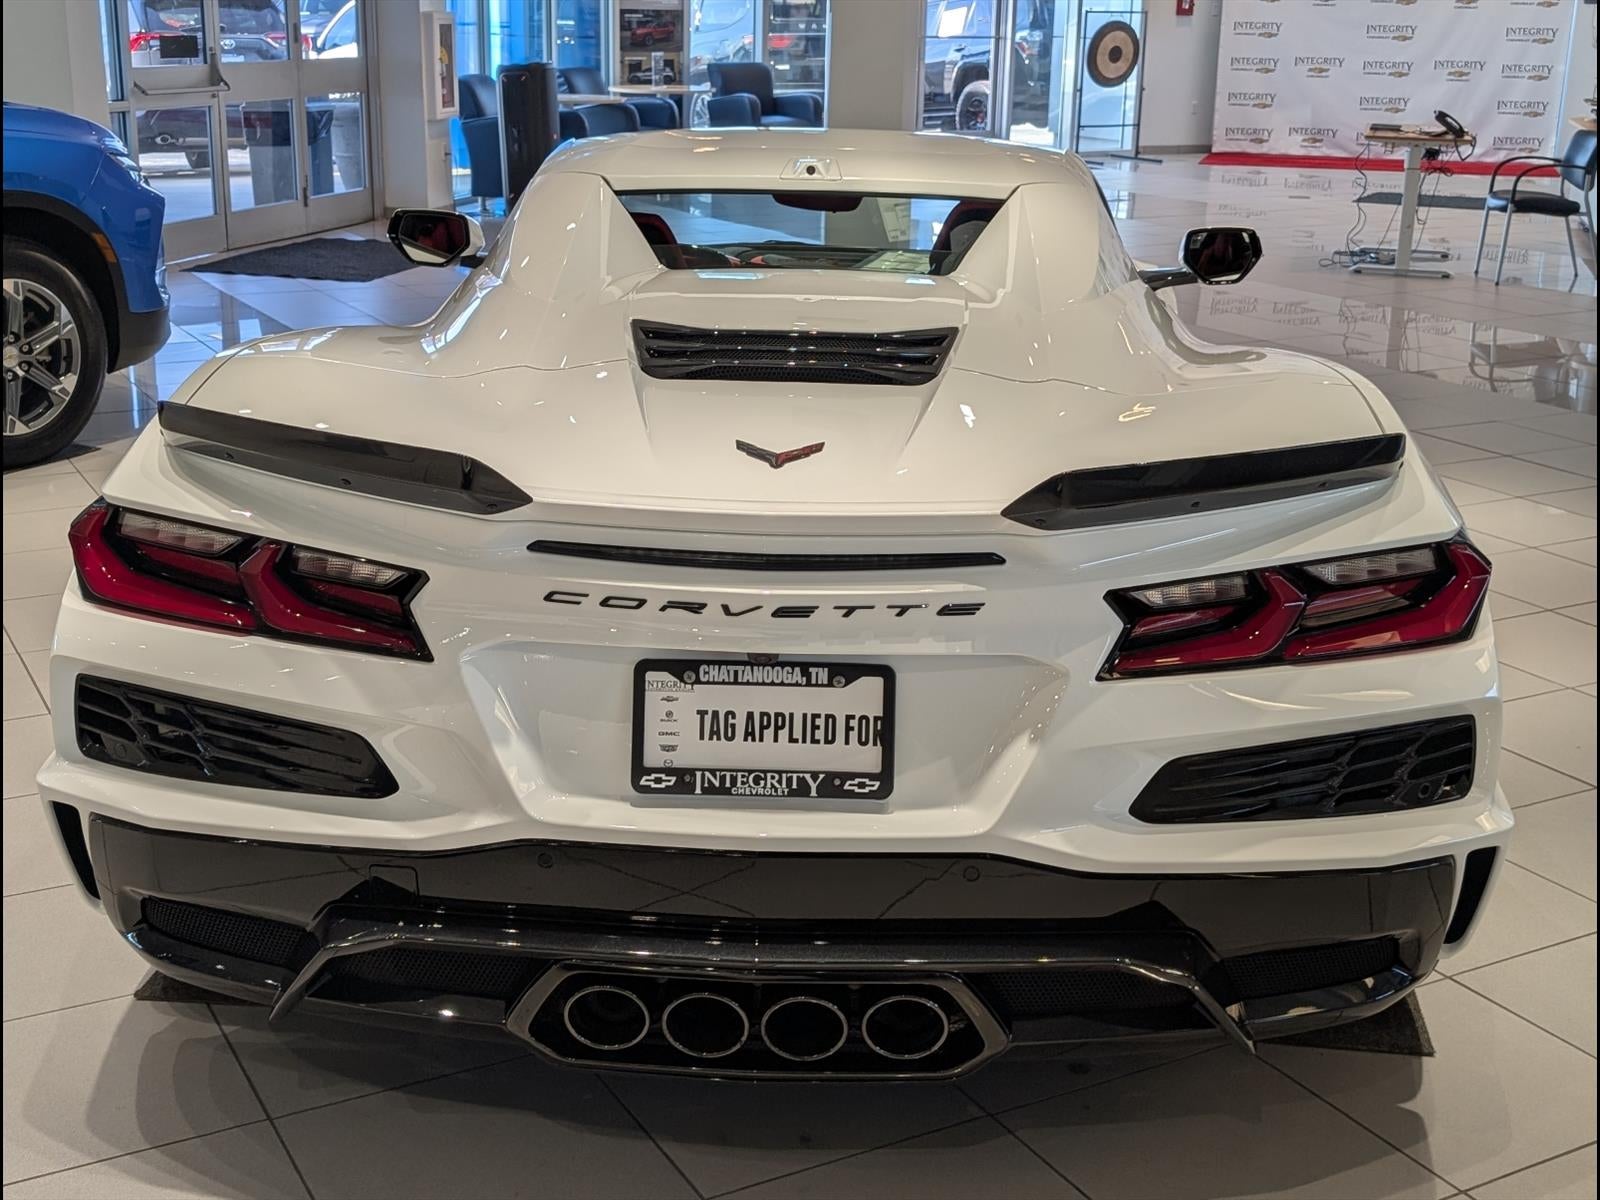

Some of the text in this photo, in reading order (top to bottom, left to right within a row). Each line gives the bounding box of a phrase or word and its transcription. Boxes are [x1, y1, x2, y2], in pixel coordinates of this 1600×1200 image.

[1233, 21, 1283, 32] INTEGRITY
[1366, 24, 1417, 35] INTEGRITY
[1505, 27, 1559, 38] INTEGRITY
[1230, 56, 1280, 68] INTEGRITY
[1294, 56, 1345, 68] INTEGRITY
[1363, 60, 1414, 71] INTEGRITY
[1433, 60, 1486, 71] INTEGRITY
[1501, 63, 1554, 75] INTEGRITY
[1227, 92, 1276, 103] INTEGRITY
[1360, 96, 1410, 107] INTEGRITY
[1497, 100, 1549, 111] INTEGRITY
[1225, 127, 1273, 138] INTEGRITY
[1288, 127, 1338, 138] INTEGRITY
[1492, 136, 1544, 147] INTEGRITY
[543, 590, 986, 618] CORVETTE
[699, 664, 829, 686] CHATTANOOGA, TN
[696, 709, 883, 747] TAG APPLIED FOR
[694, 770, 826, 797] INTEGRITY
[731, 786, 789, 796] CHEVROLET
